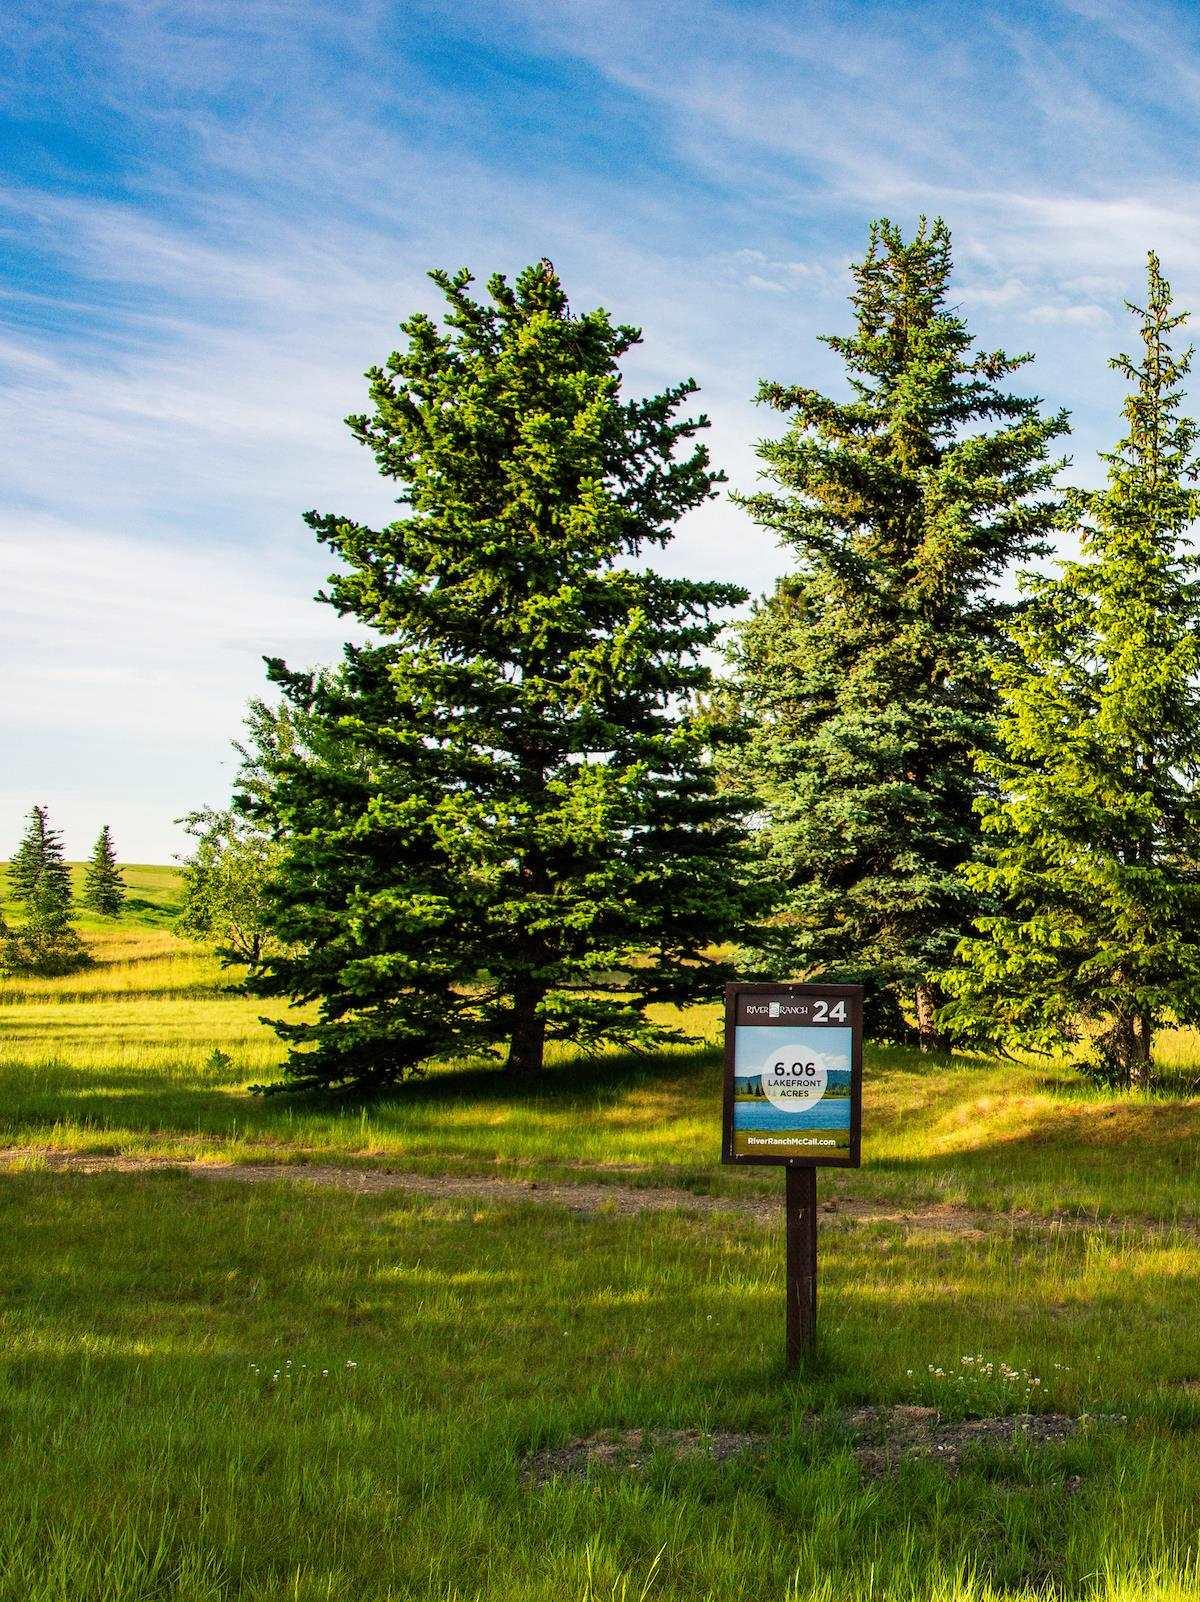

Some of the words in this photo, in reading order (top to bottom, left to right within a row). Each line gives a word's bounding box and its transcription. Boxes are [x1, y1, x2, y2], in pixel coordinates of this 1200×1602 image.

[746, 1005, 769, 1014] RIVER
[779, 1005, 808, 1014] RANCH
[812, 1000, 847, 1023] 24
[774, 1062, 816, 1076] 6.06
[768, 1079, 822, 1087] LAKEFRONT
[779, 1089, 809, 1098] ACRES
[748, 1137, 836, 1146] RiverRanchMcCall.com
